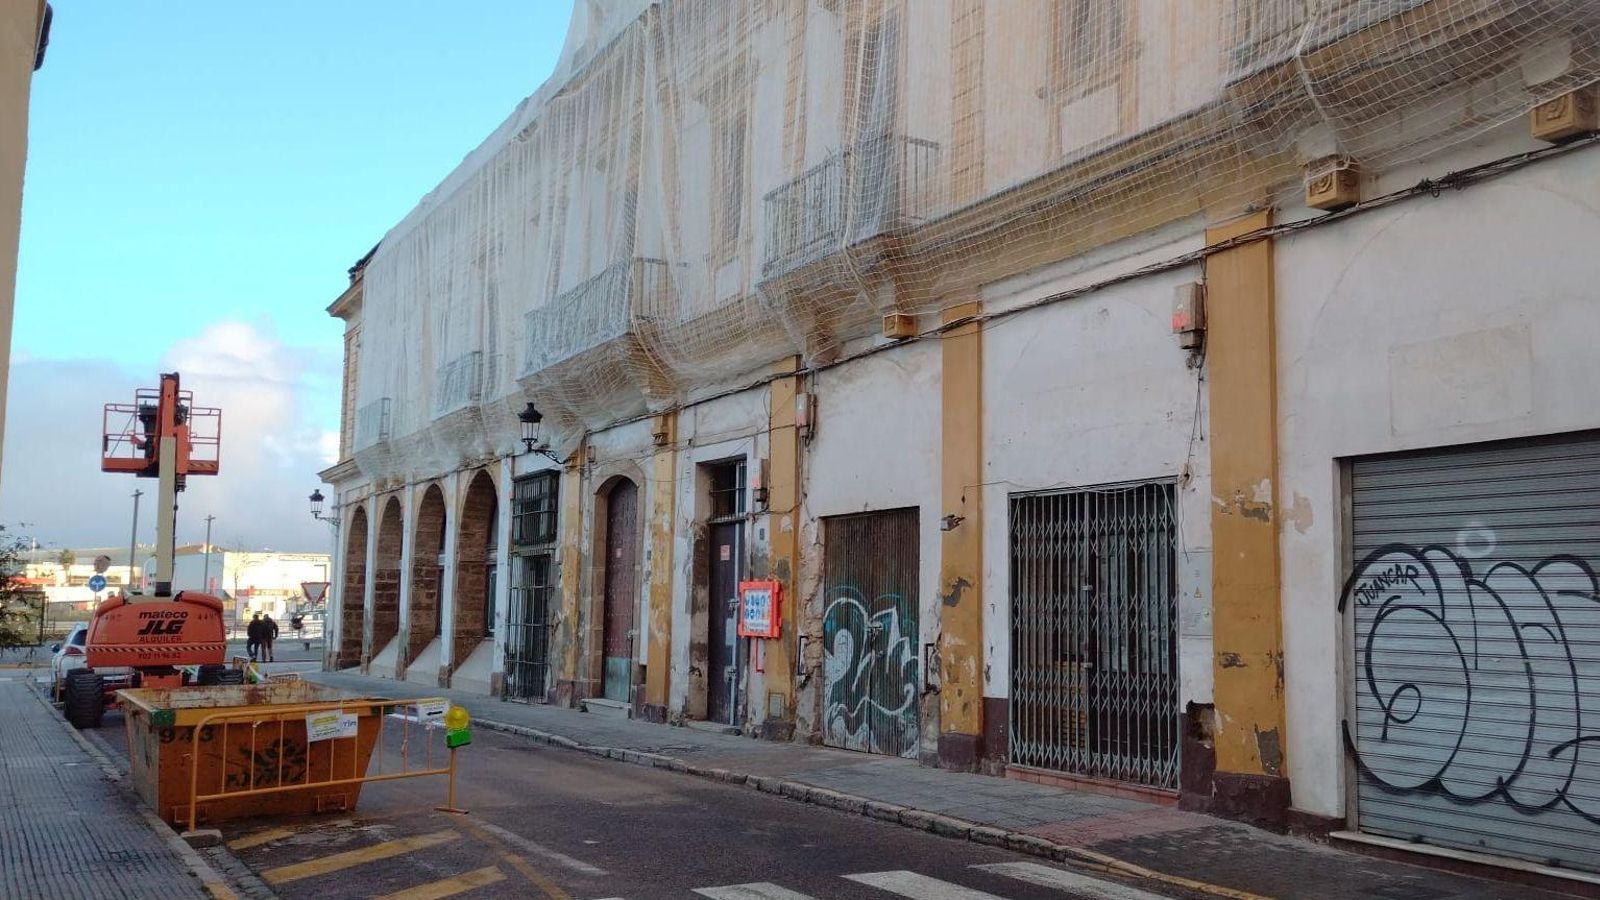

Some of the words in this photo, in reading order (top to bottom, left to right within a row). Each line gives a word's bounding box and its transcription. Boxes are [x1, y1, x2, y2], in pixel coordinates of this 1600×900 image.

[1353, 563, 1425, 606] JUANCAR
[139, 611, 188, 619] mateco
[137, 620, 185, 635] JLG
[139, 635, 182, 643] ALQUILER
